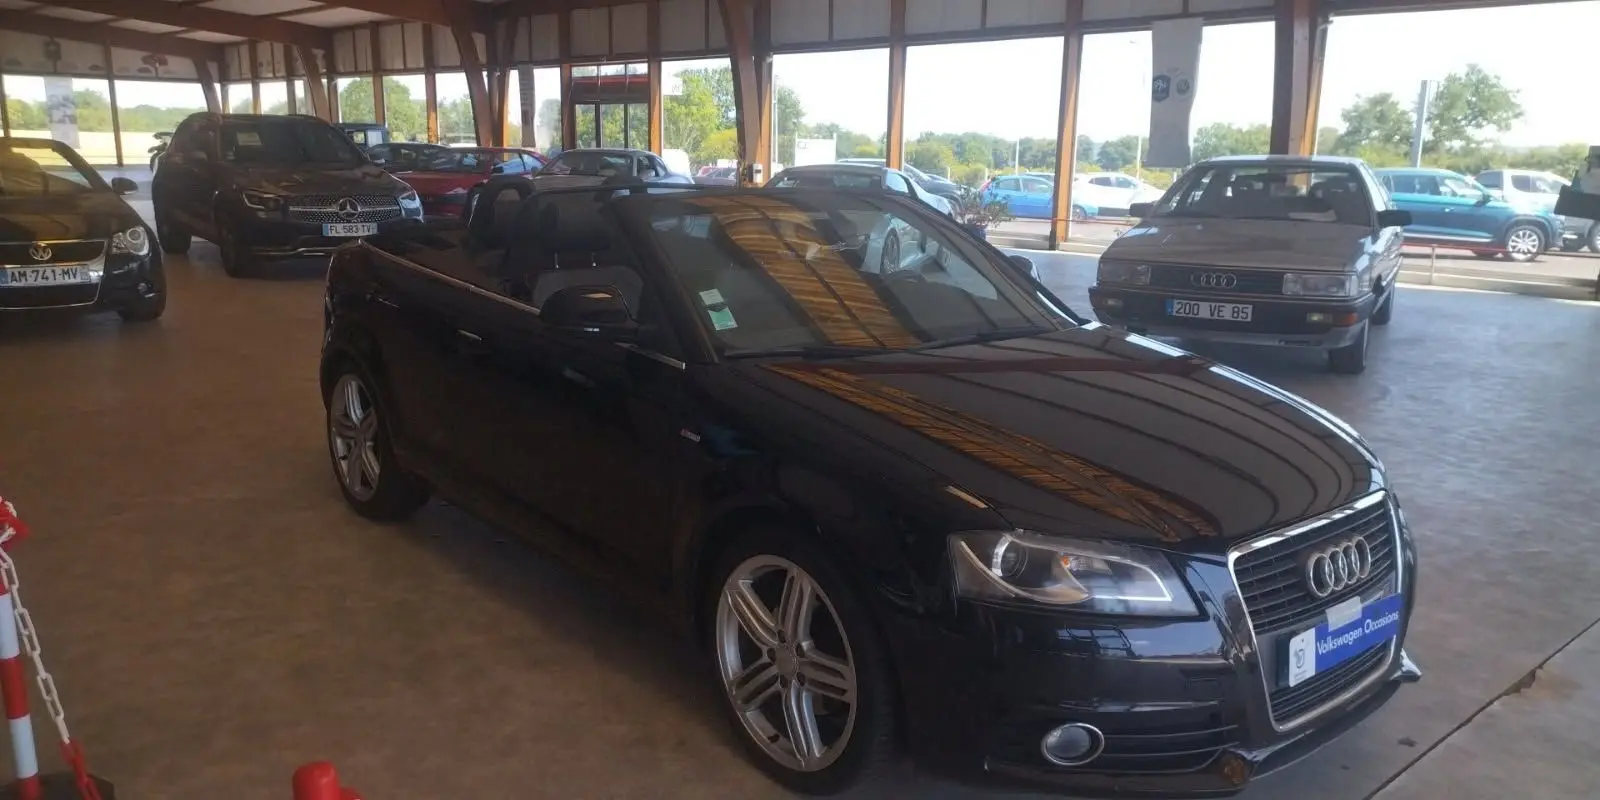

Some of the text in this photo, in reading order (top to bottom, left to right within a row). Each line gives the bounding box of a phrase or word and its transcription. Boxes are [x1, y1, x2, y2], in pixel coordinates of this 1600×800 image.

[1175, 301, 1250, 320] 200 VE 85
[1317, 610, 1400, 656] Volkswagen Occasions
